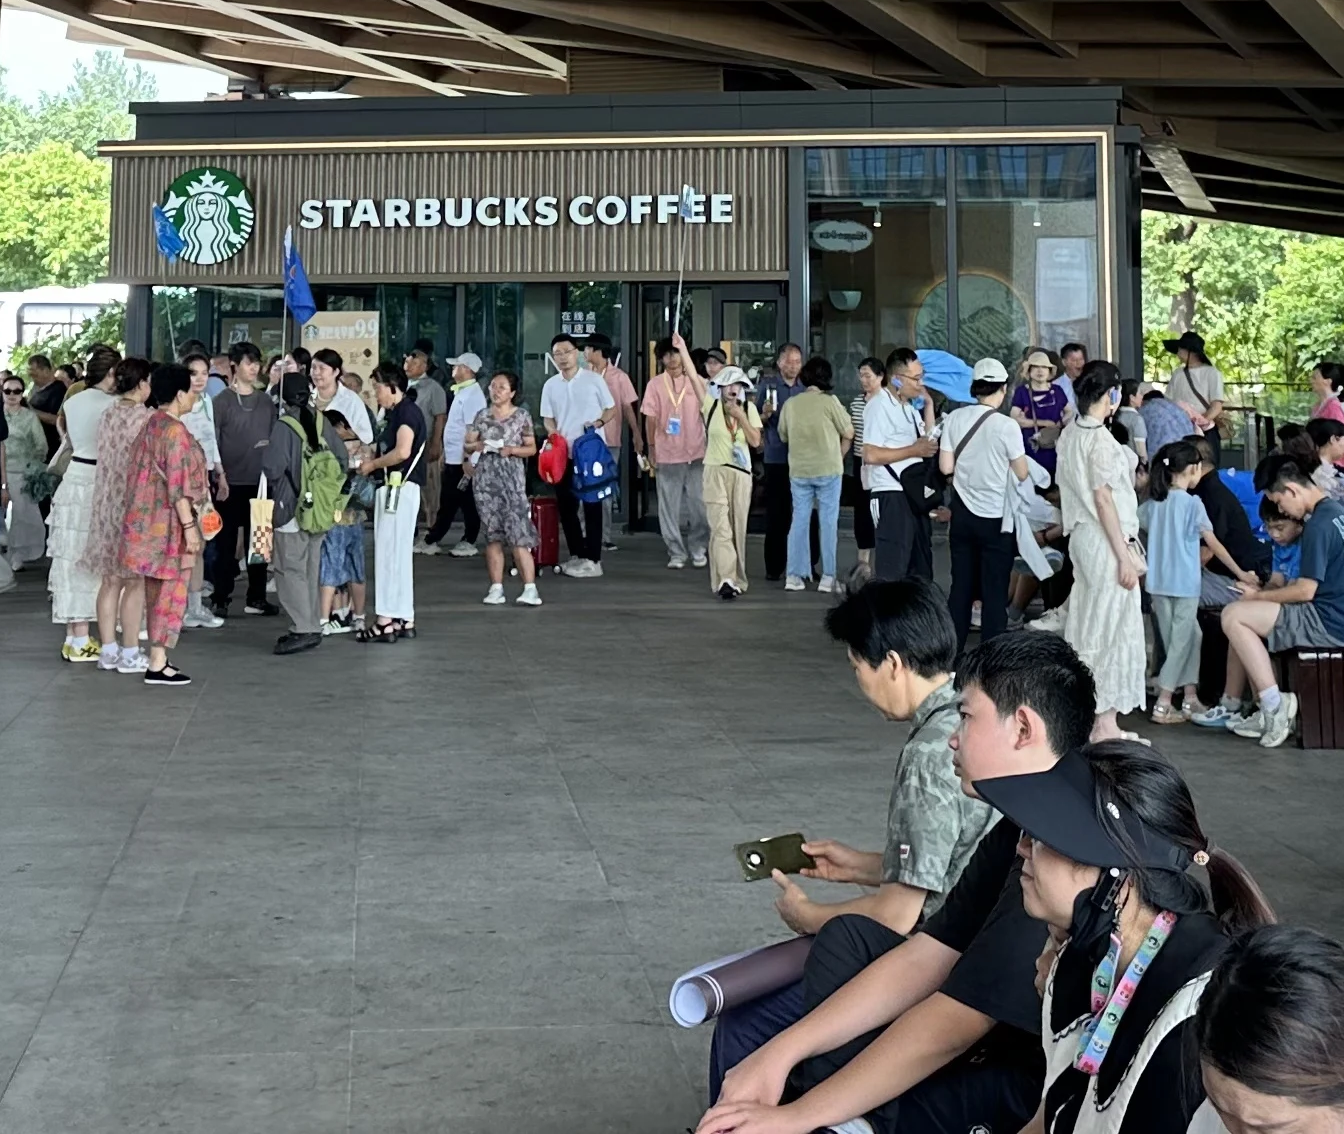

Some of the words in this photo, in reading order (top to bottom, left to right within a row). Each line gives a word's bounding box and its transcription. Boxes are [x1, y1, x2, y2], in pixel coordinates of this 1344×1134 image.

[299, 195, 558, 229] STARBUCKS
[568, 194, 734, 227] COFFEE
[561, 311, 596, 322] 在线点
[561, 324, 596, 334] 到店取
